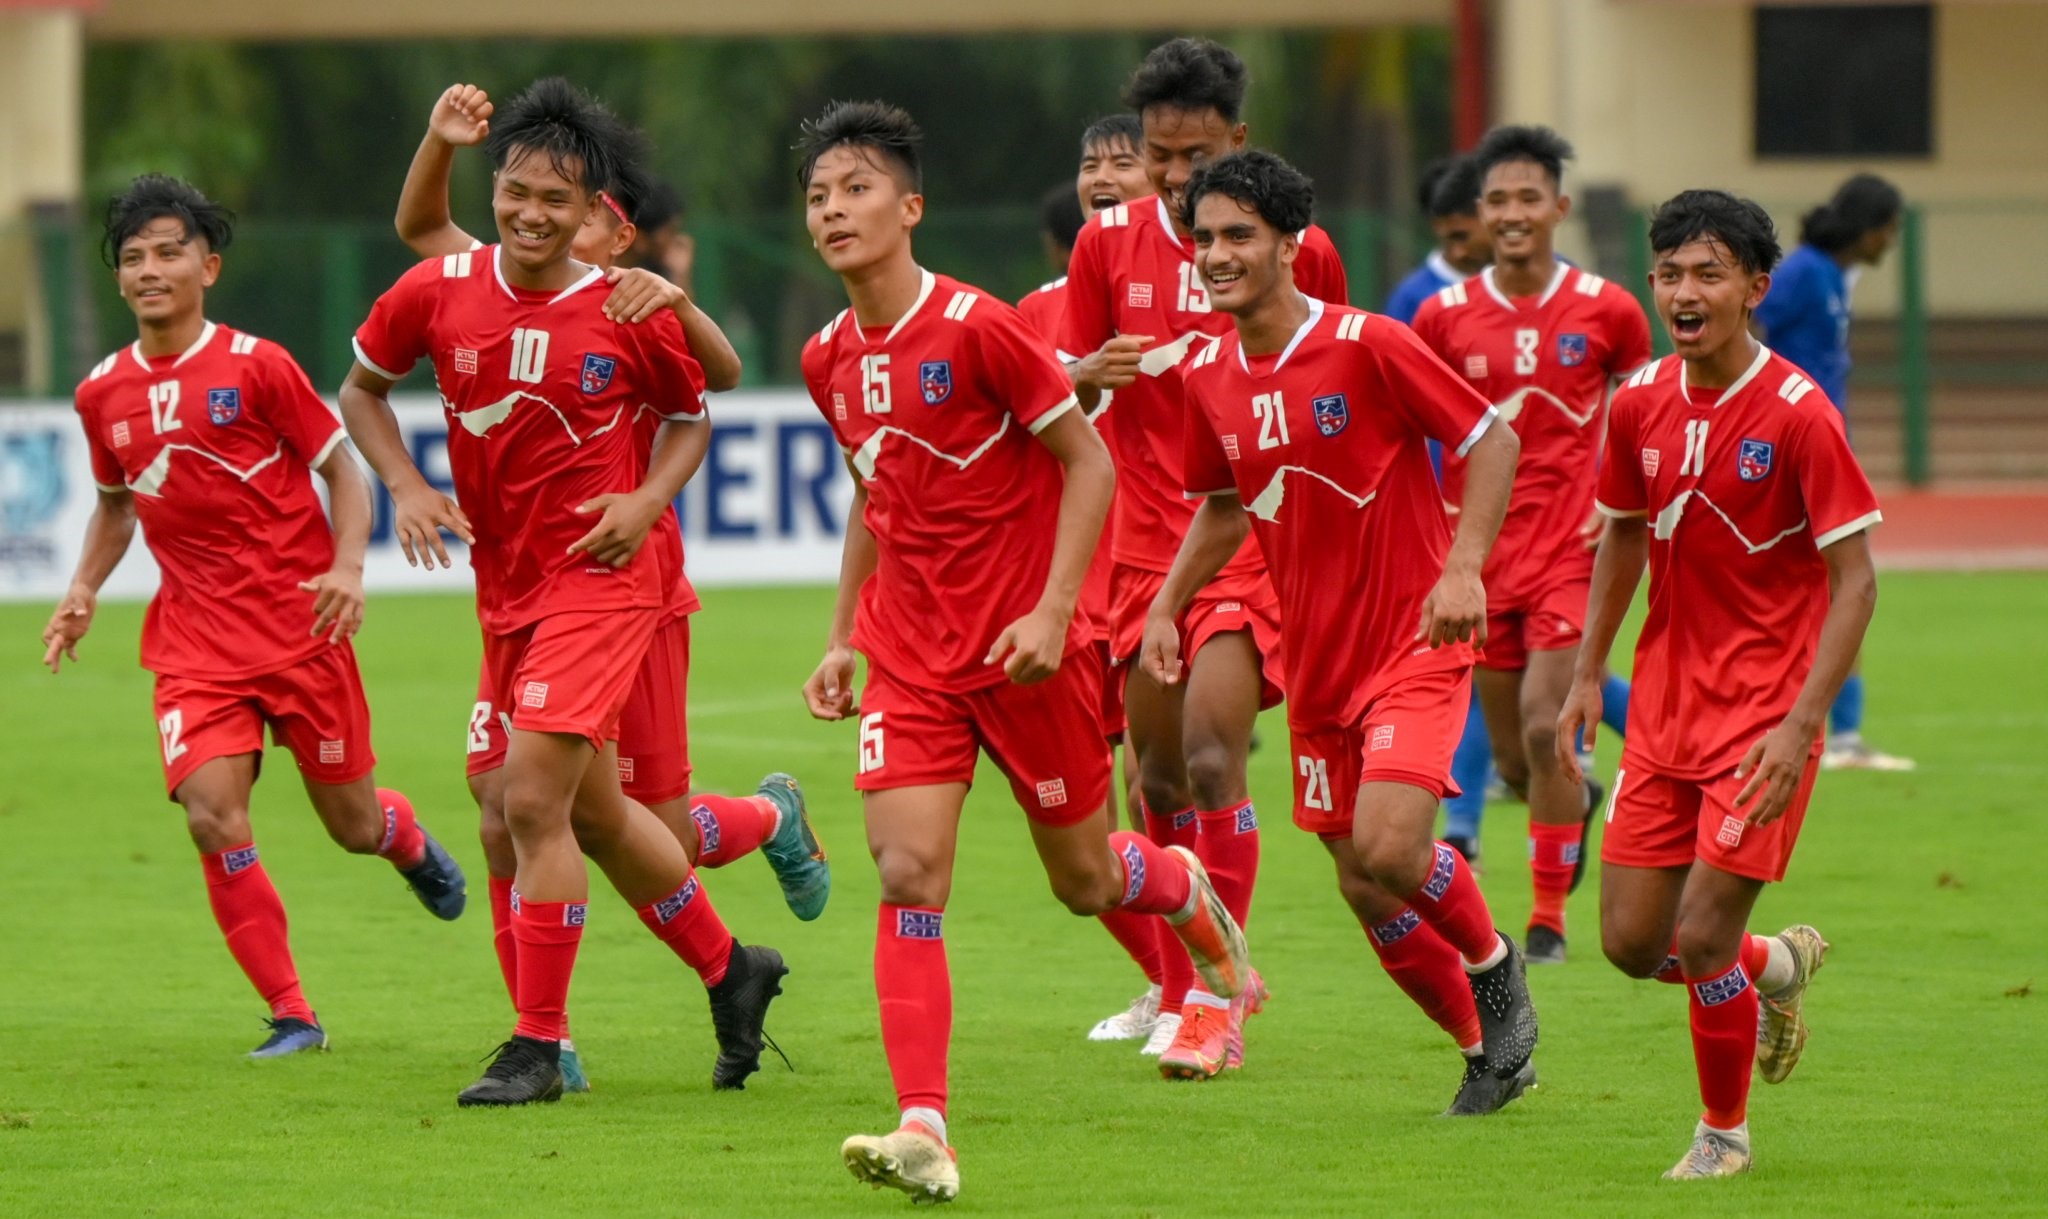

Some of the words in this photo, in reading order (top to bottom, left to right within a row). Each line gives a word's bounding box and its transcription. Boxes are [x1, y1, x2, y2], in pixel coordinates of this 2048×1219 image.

[1131, 286, 1150, 294] KTM
[1131, 297, 1149, 305] CTY
[456, 362, 475, 371] CTY
[457, 350, 476, 360] KTM
[509, 327, 550, 384] 10
[1515, 328, 1540, 375] 3
[860, 353, 892, 414] 15
[147, 379, 183, 435] 12
[1252, 390, 1290, 450] 21
[1680, 419, 1709, 477] 11
[859, 711, 885, 775] 15
[1040, 782, 1061, 794] KTM
[1299, 755, 1333, 811] 21
[1721, 832, 1738, 843] CTY
[1726, 821, 1742, 832] KTM
[1428, 850, 1446, 889] KTM
[1702, 971, 1740, 993] KTM
[1706, 982, 1747, 1004] CTY
